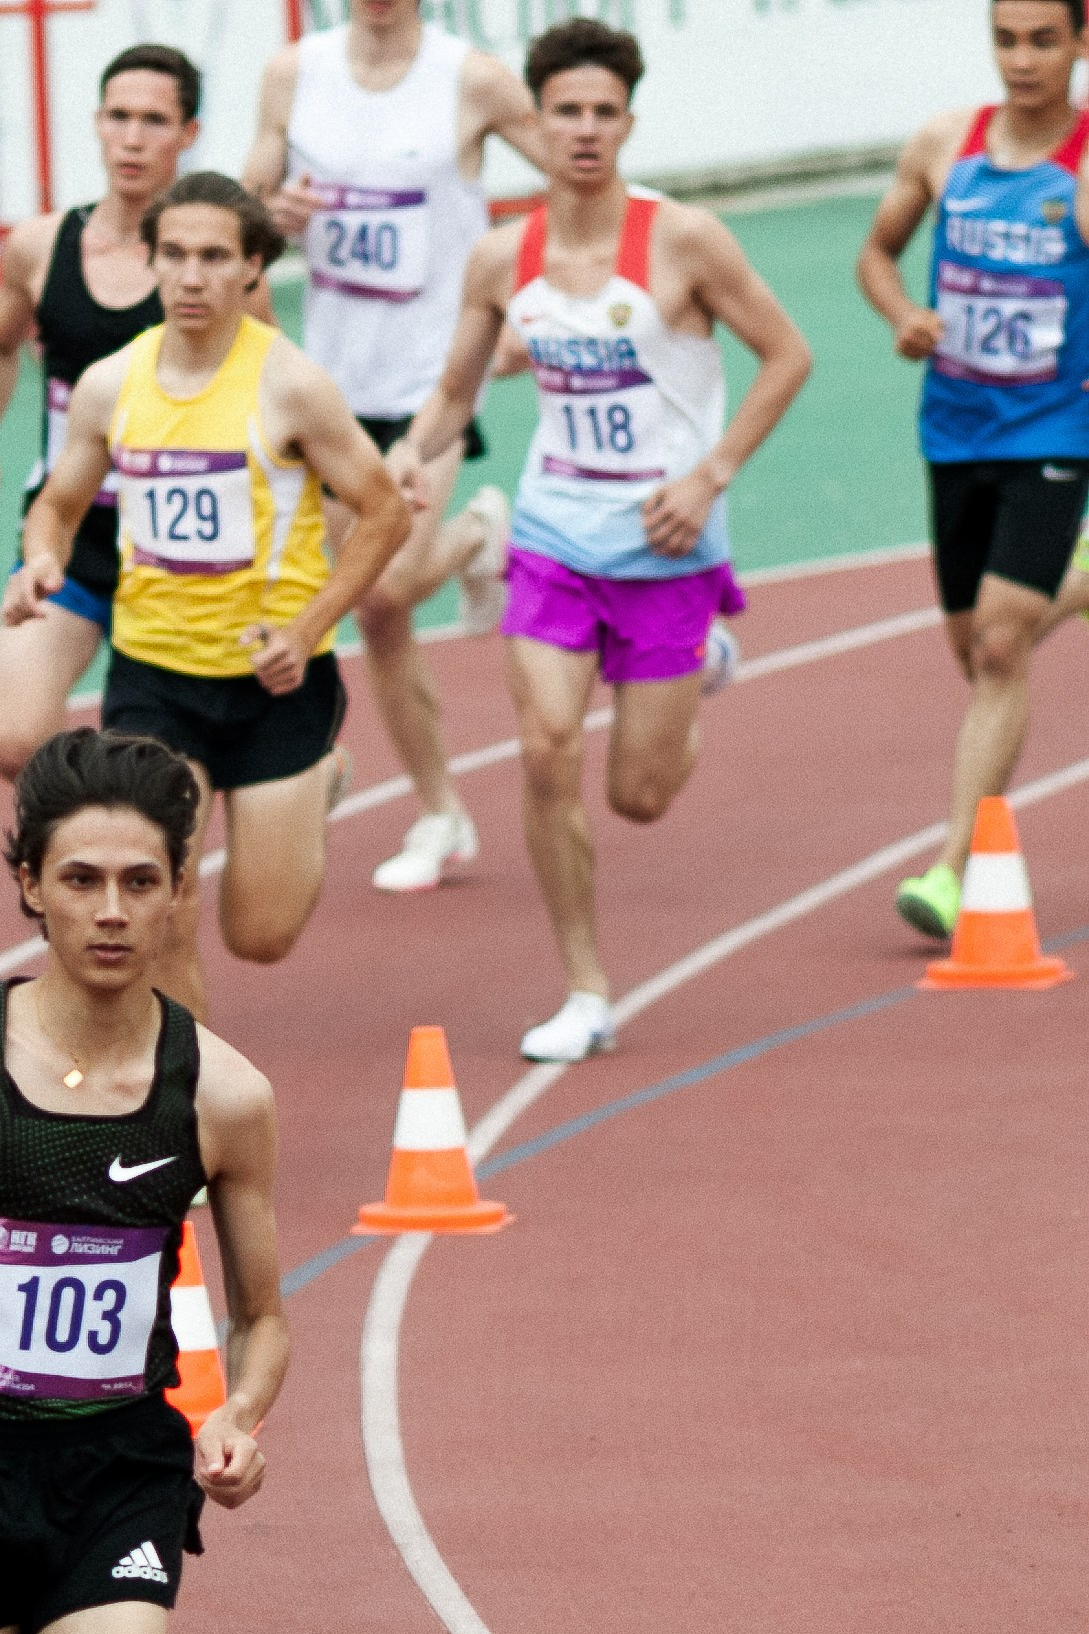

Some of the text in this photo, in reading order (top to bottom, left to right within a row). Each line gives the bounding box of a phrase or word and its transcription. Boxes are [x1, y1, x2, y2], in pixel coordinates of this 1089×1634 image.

[325, 219, 399, 269] 240
[947, 217, 1066, 264] RUSSIA
[965, 304, 1033, 358] 126
[563, 404, 634, 453] 118
[144, 488, 220, 542] 129
[16, 1275, 127, 1355] 103
[112, 1566, 168, 1584] adidas
